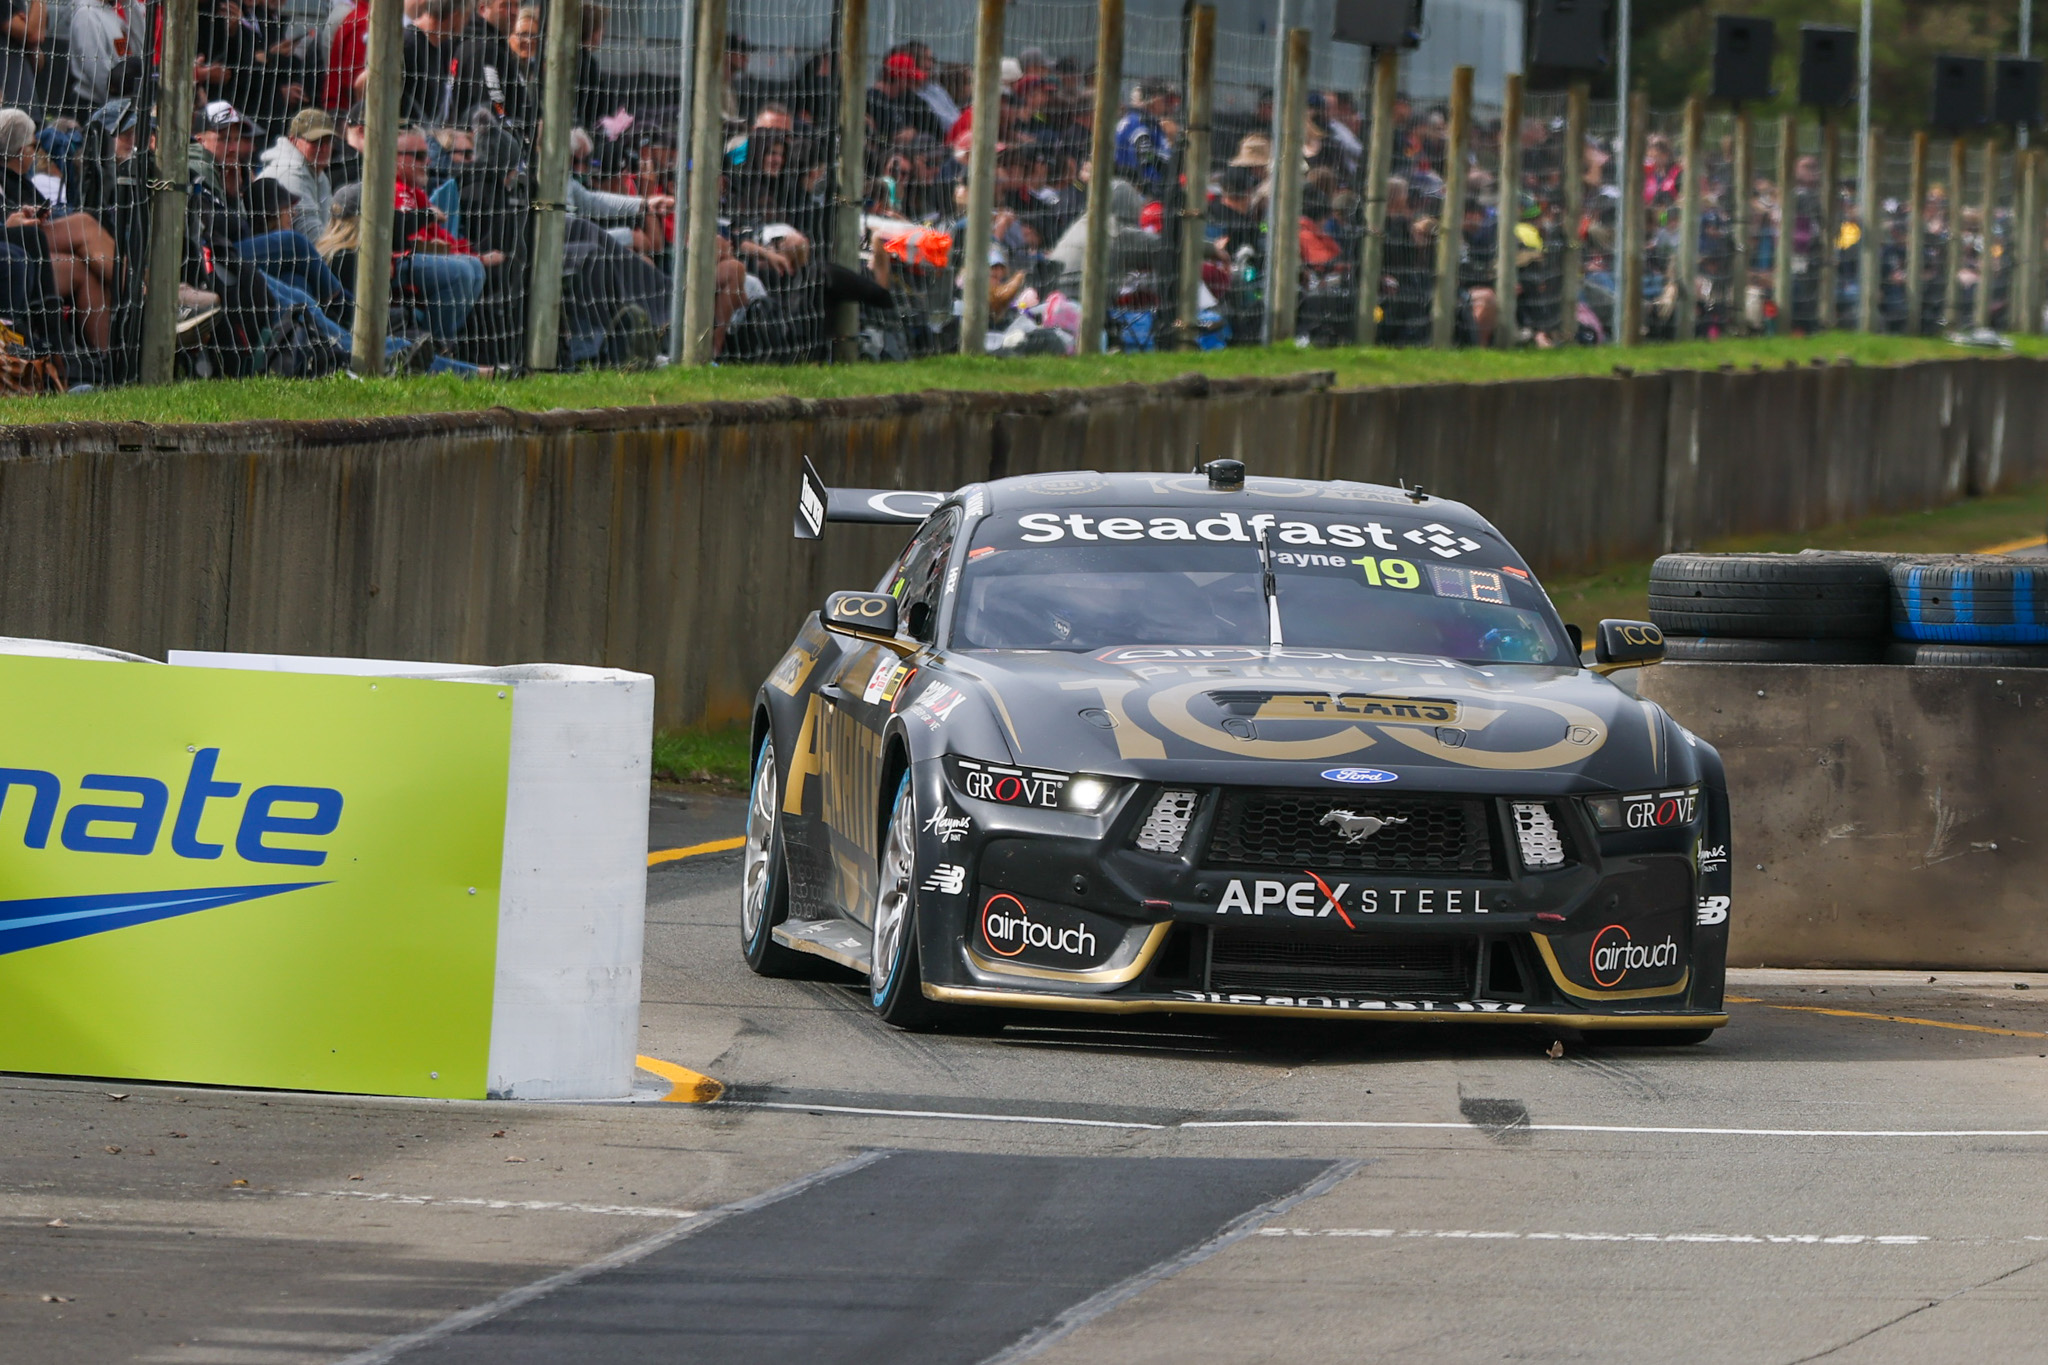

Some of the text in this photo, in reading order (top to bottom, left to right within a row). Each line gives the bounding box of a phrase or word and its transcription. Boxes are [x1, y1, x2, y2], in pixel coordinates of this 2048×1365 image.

[1018, 512, 1398, 551] Steadfast
[1352, 556, 1420, 590] 19
[1336, 768, 1383, 782] Ford
[922, 805, 971, 843] Haymes
[1626, 796, 1695, 829] GROVE
[1216, 871, 1489, 929] APEX STEEL
[987, 911, 1096, 957] airtouch
[1594, 934, 1679, 971] airtouch
